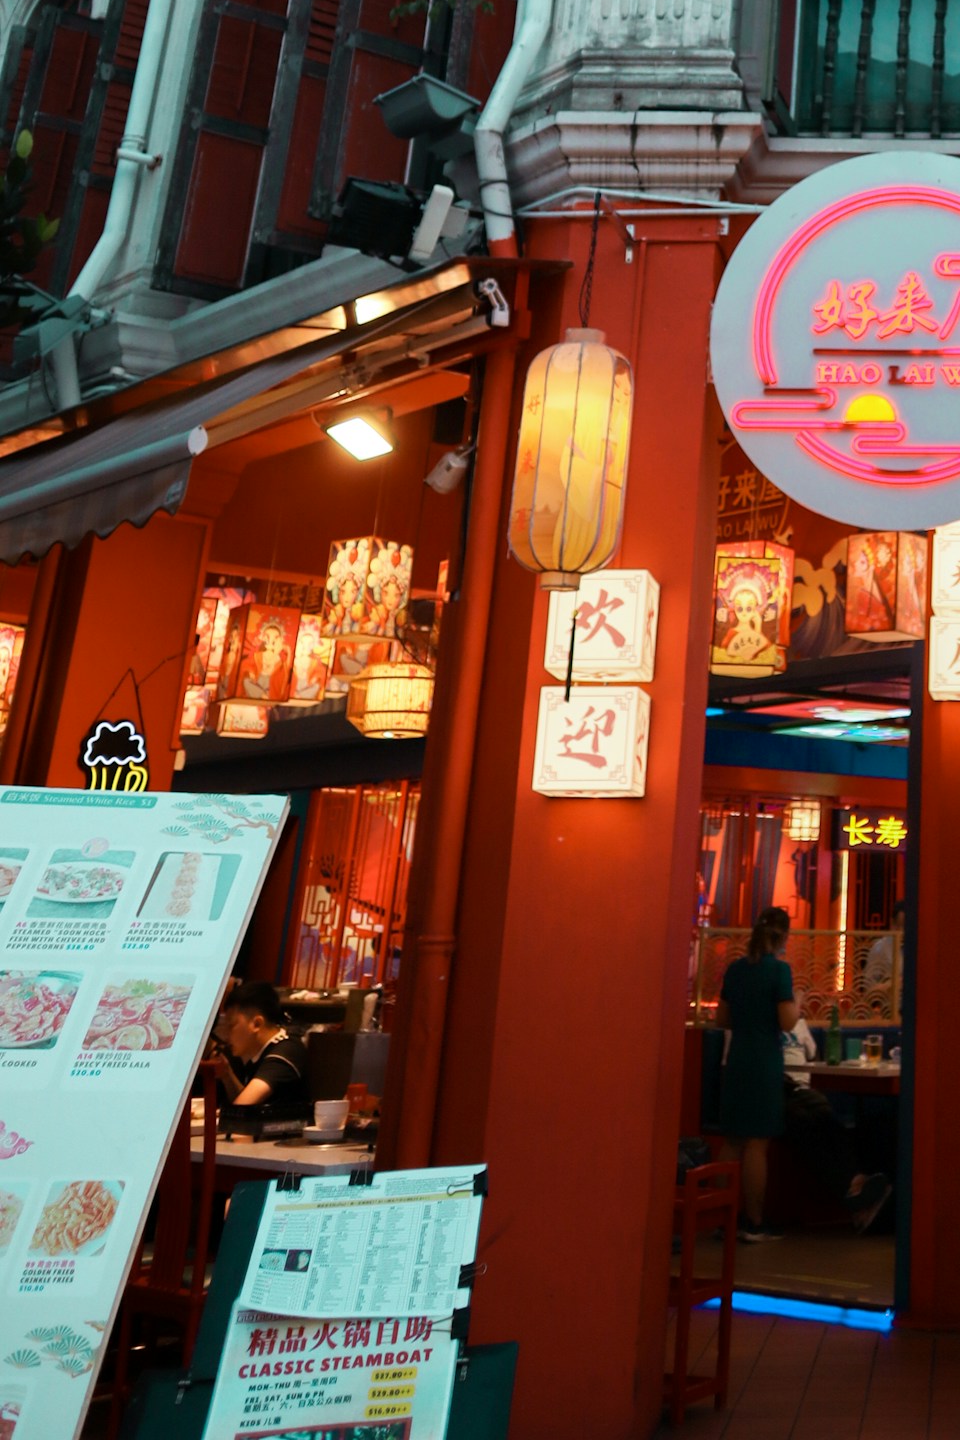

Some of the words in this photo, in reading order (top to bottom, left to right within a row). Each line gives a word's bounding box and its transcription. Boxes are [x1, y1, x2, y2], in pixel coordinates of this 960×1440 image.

[817, 364, 881, 385] HAO
[888, 364, 934, 385] LAI
[43, 795, 85, 804] Steamed
[86, 796, 113, 806] White
[115, 798, 136, 806] Rice
[843, 815, 908, 848] 长寿
[1, 1060, 37, 1068] COOKED
[20, 1276, 51, 1284] CRINKLE
[246, 1316, 433, 1357] 精品火锅自助
[238, 1359, 315, 1379] CLASSIC
[320, 1348, 433, 1372] STEAMBOAT
[248, 1381, 292, 1392] MON-THU
[286, 1392, 303, 1402] SUN
[312, 1390, 325, 1399] PH
[239, 1418, 262, 1428] KIDS
[263, 1416, 282, 1426] 儿童
